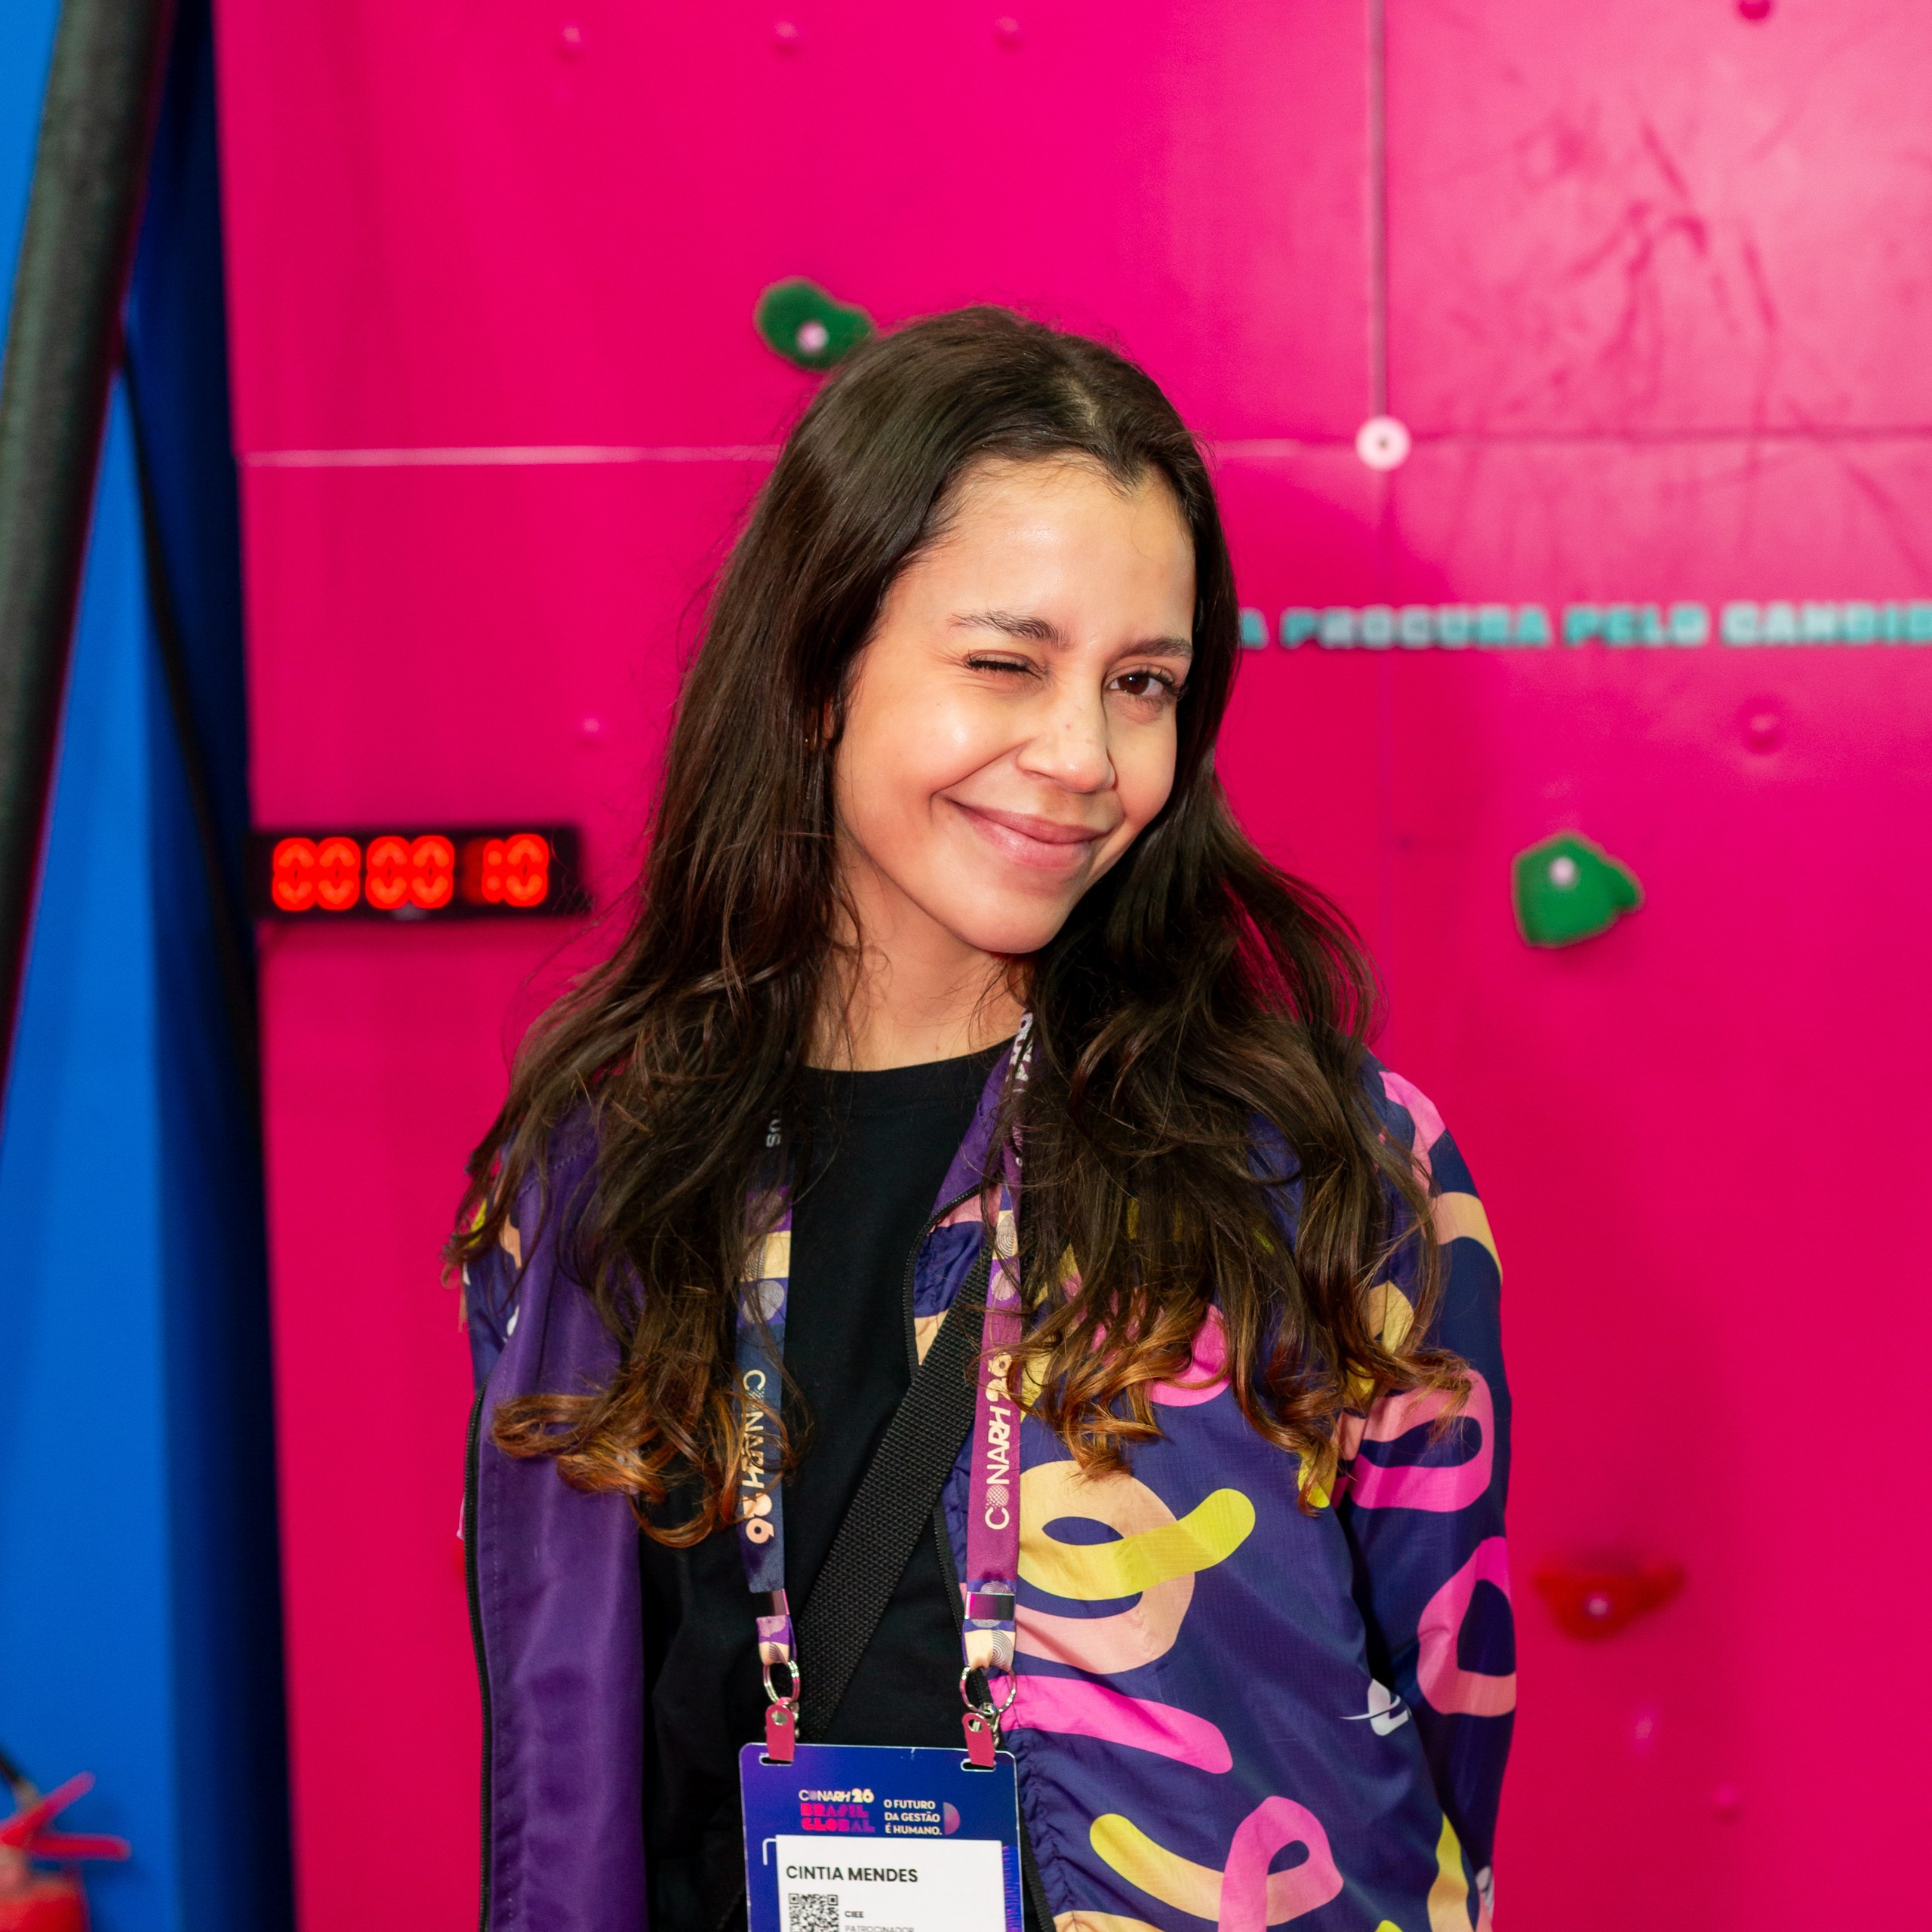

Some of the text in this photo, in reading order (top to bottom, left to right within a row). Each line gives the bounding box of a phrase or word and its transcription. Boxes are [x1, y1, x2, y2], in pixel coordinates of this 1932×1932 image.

[1279, 605, 1550, 649] PROCURA
[1563, 603, 1710, 648] PELO
[800, 1802, 869, 1817] BRASIL
[883, 1799, 936, 1810] O FUTURO
[884, 1810, 940, 1823] DA GESTÃO
[801, 1817, 875, 1832] GLOBAL
[884, 1823, 943, 1835] É HUMANO.
[786, 1865, 918, 1882] CINTIA MENDES
